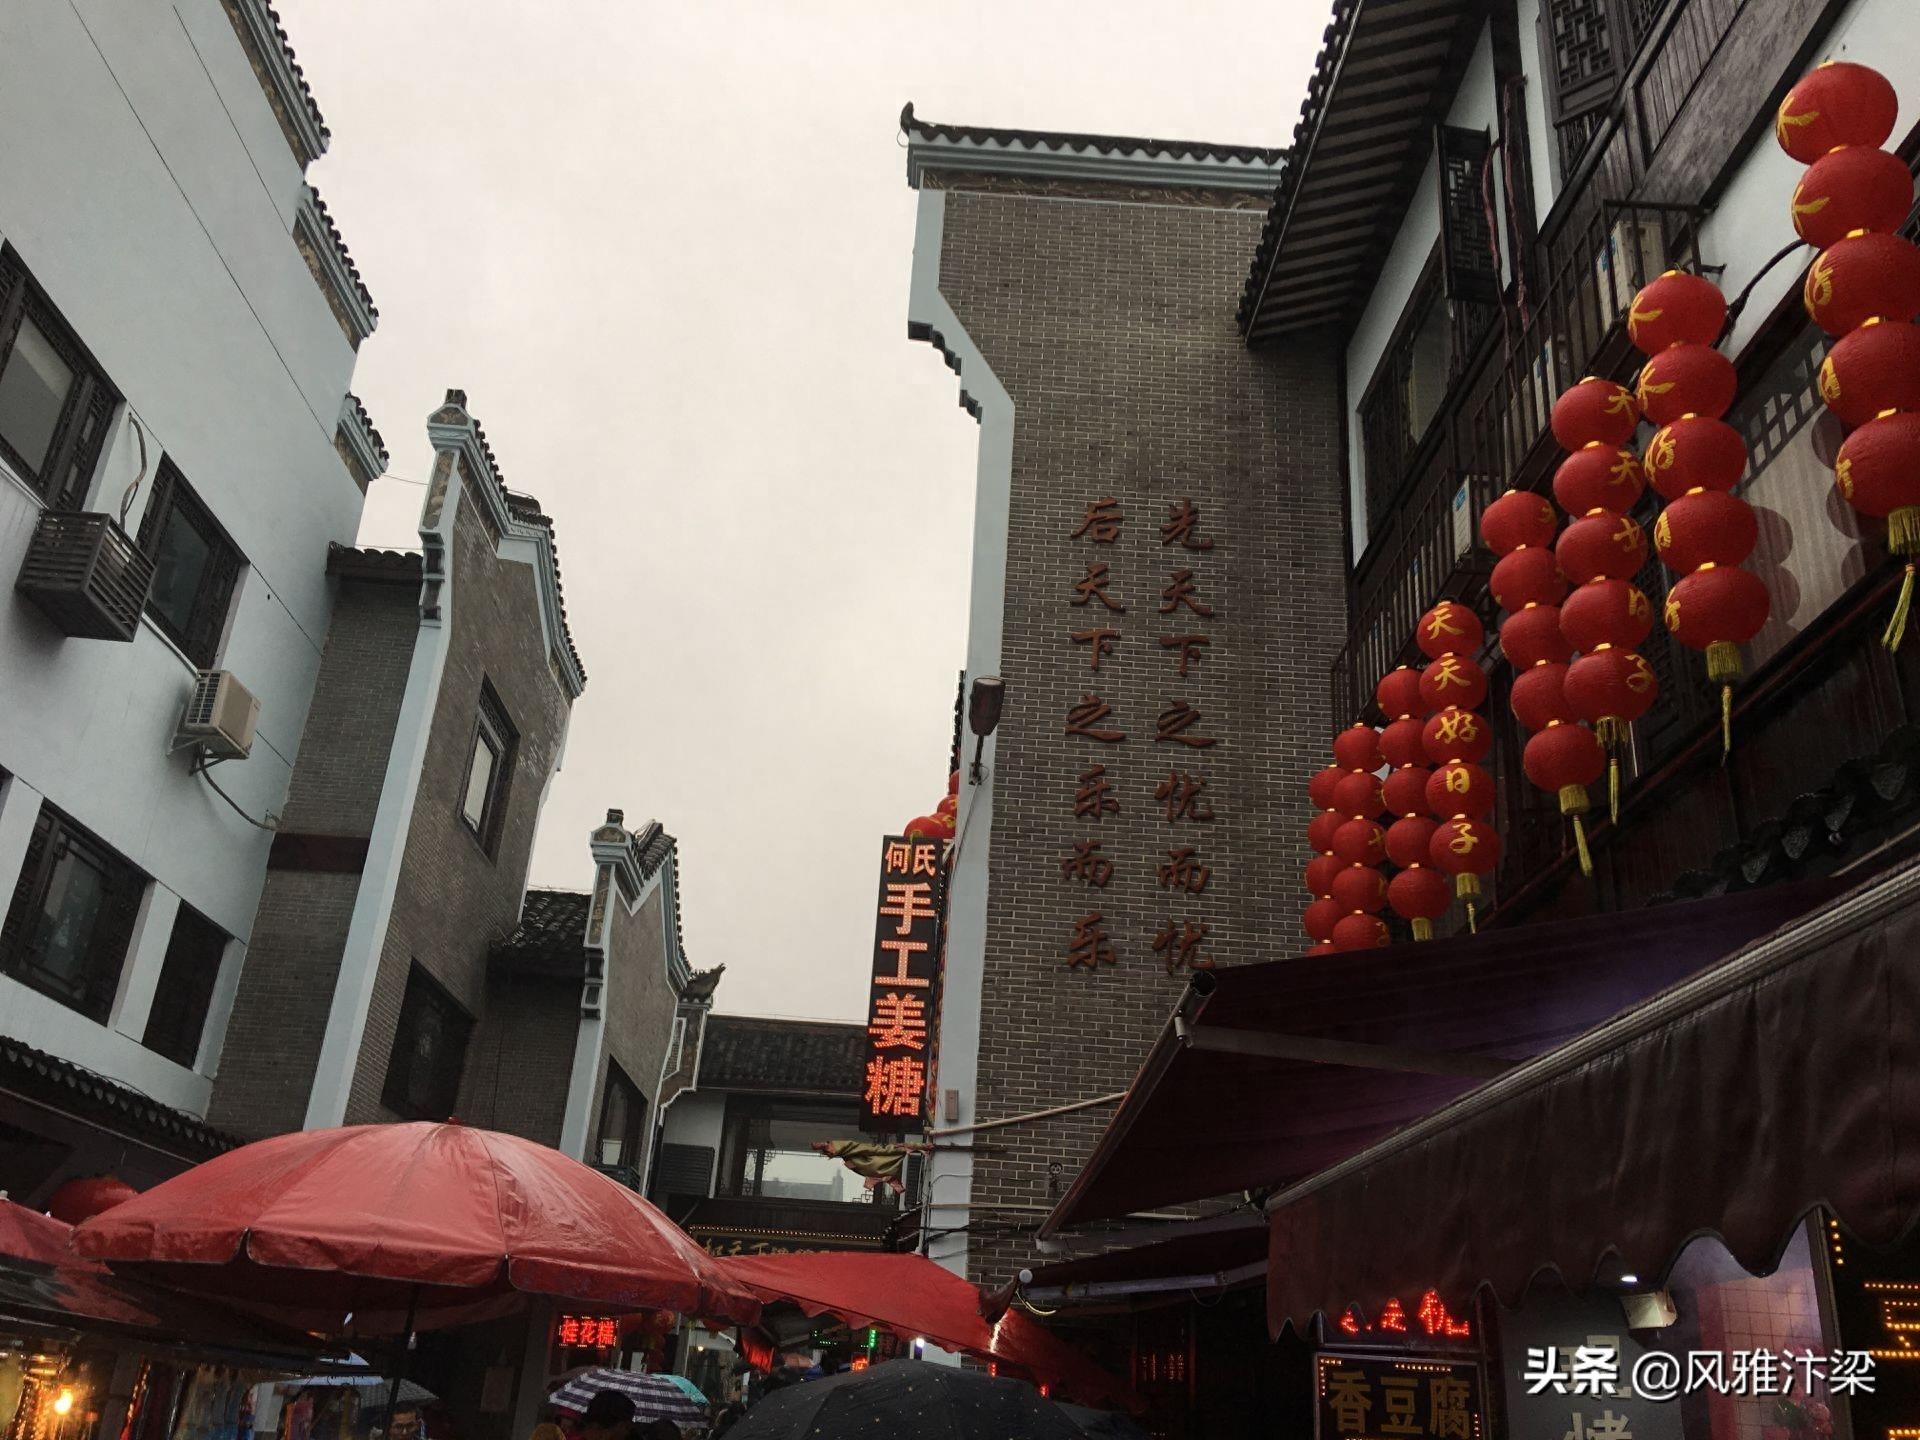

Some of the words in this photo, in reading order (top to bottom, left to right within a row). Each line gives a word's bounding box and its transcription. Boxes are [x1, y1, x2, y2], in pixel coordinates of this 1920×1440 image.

[1062, 497, 1126, 971] 后天下之乐而乐
[1152, 498, 1216, 976] 先天下之忧而忧
[885, 840, 936, 877] 何氏
[865, 882, 936, 1116] 手工姜糖
[1329, 1371, 1471, 1440] 香豆腐
